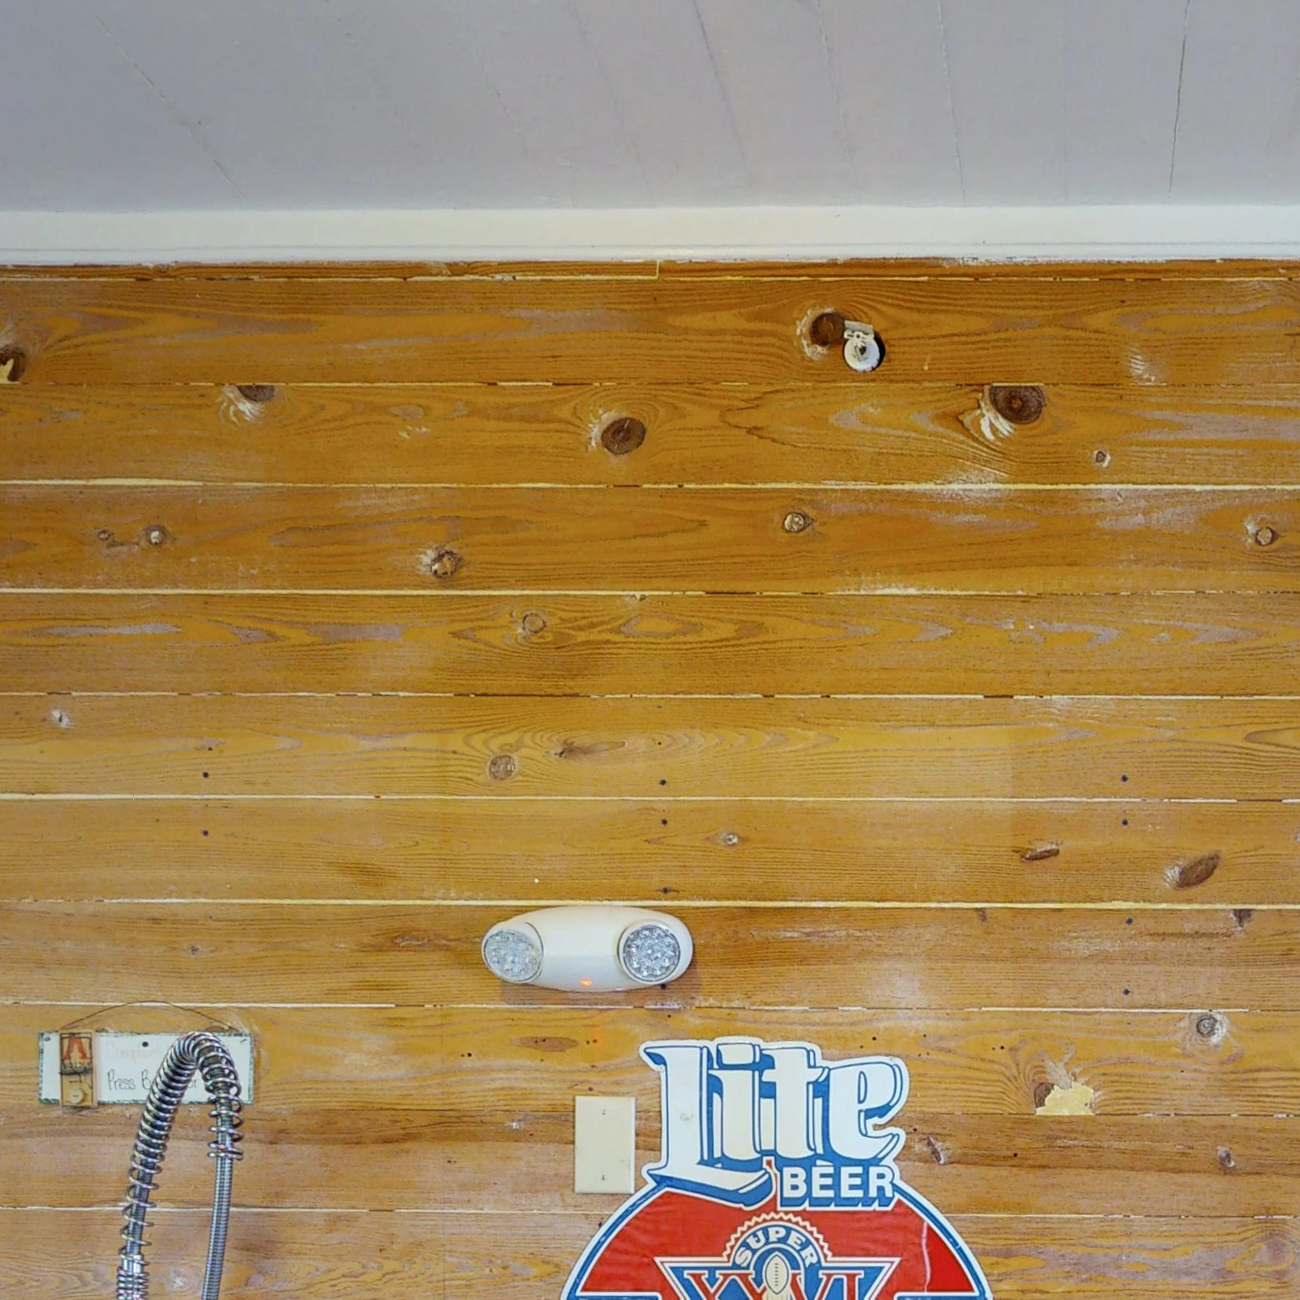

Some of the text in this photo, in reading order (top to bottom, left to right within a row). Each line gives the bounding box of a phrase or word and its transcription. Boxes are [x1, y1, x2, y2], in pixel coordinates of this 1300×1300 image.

[107, 1068, 136, 1092] Press
[643, 1042, 906, 1207] Lite
[782, 1165, 895, 1206] BEER
[734, 1226, 819, 1268] SUPER
